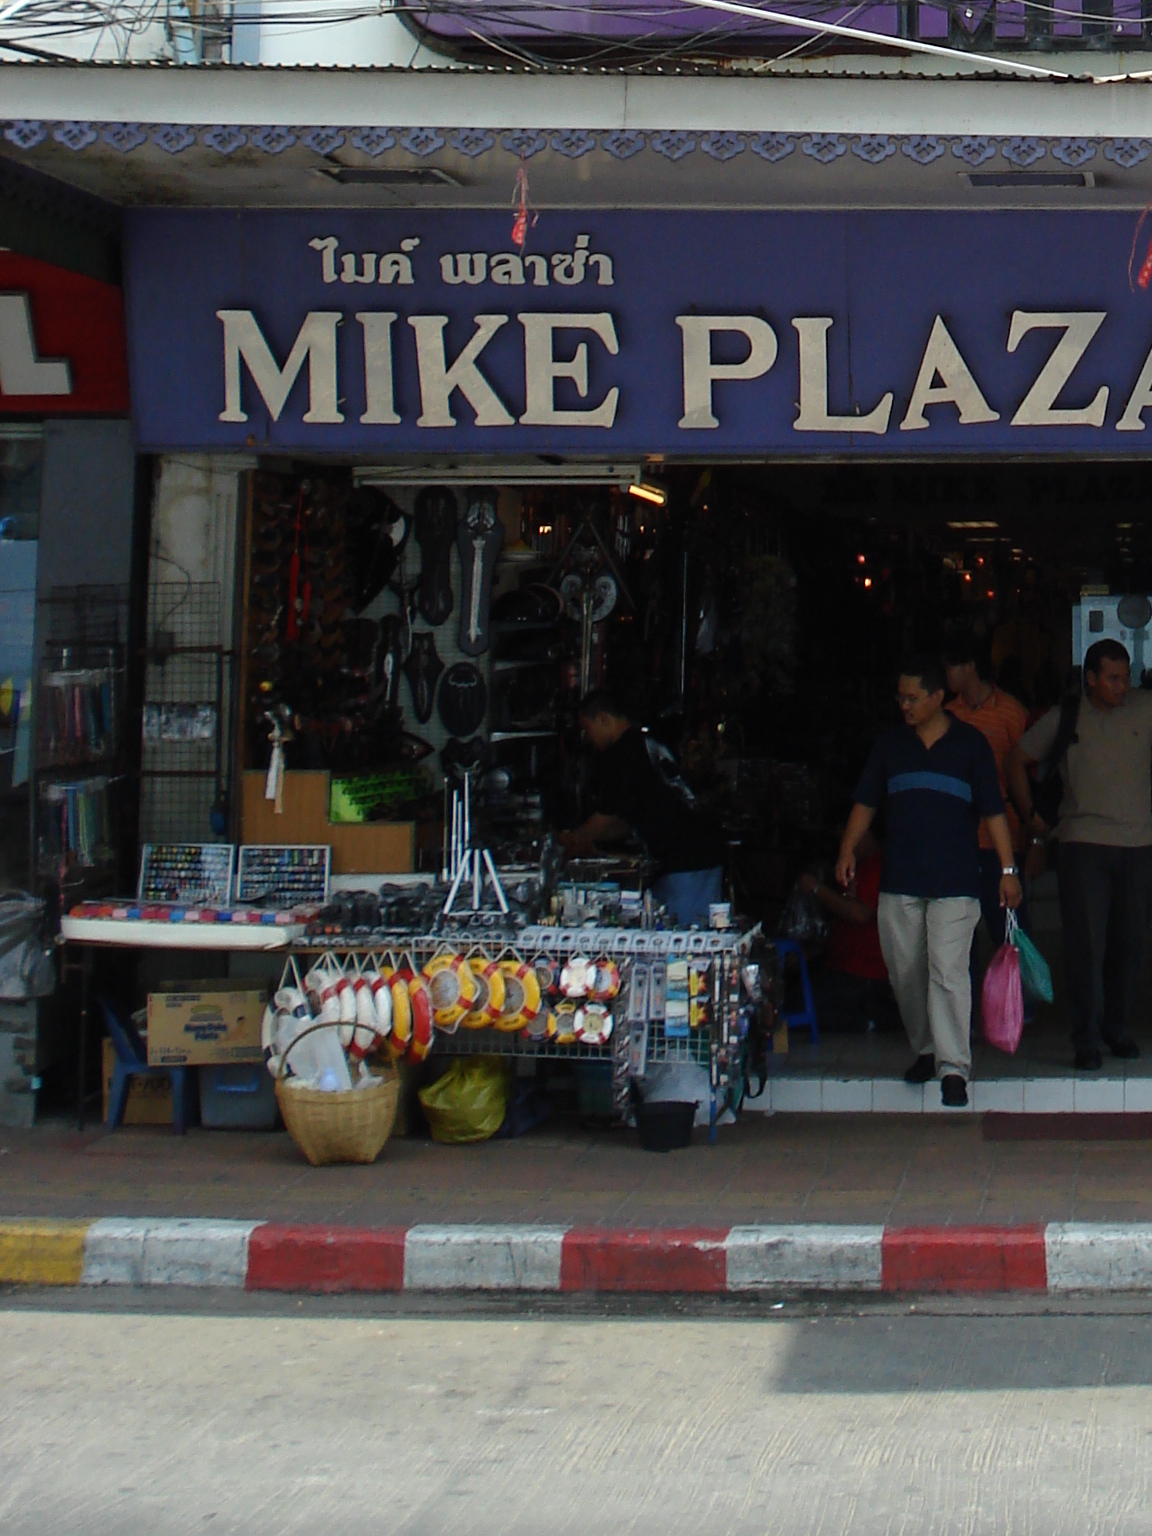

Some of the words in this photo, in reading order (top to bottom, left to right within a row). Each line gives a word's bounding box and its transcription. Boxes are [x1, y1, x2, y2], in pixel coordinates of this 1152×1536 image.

[308, 235, 420, 284] ไมค์
[439, 234, 615, 286] พลาซ่า
[216, 309, 620, 428] MIKE
